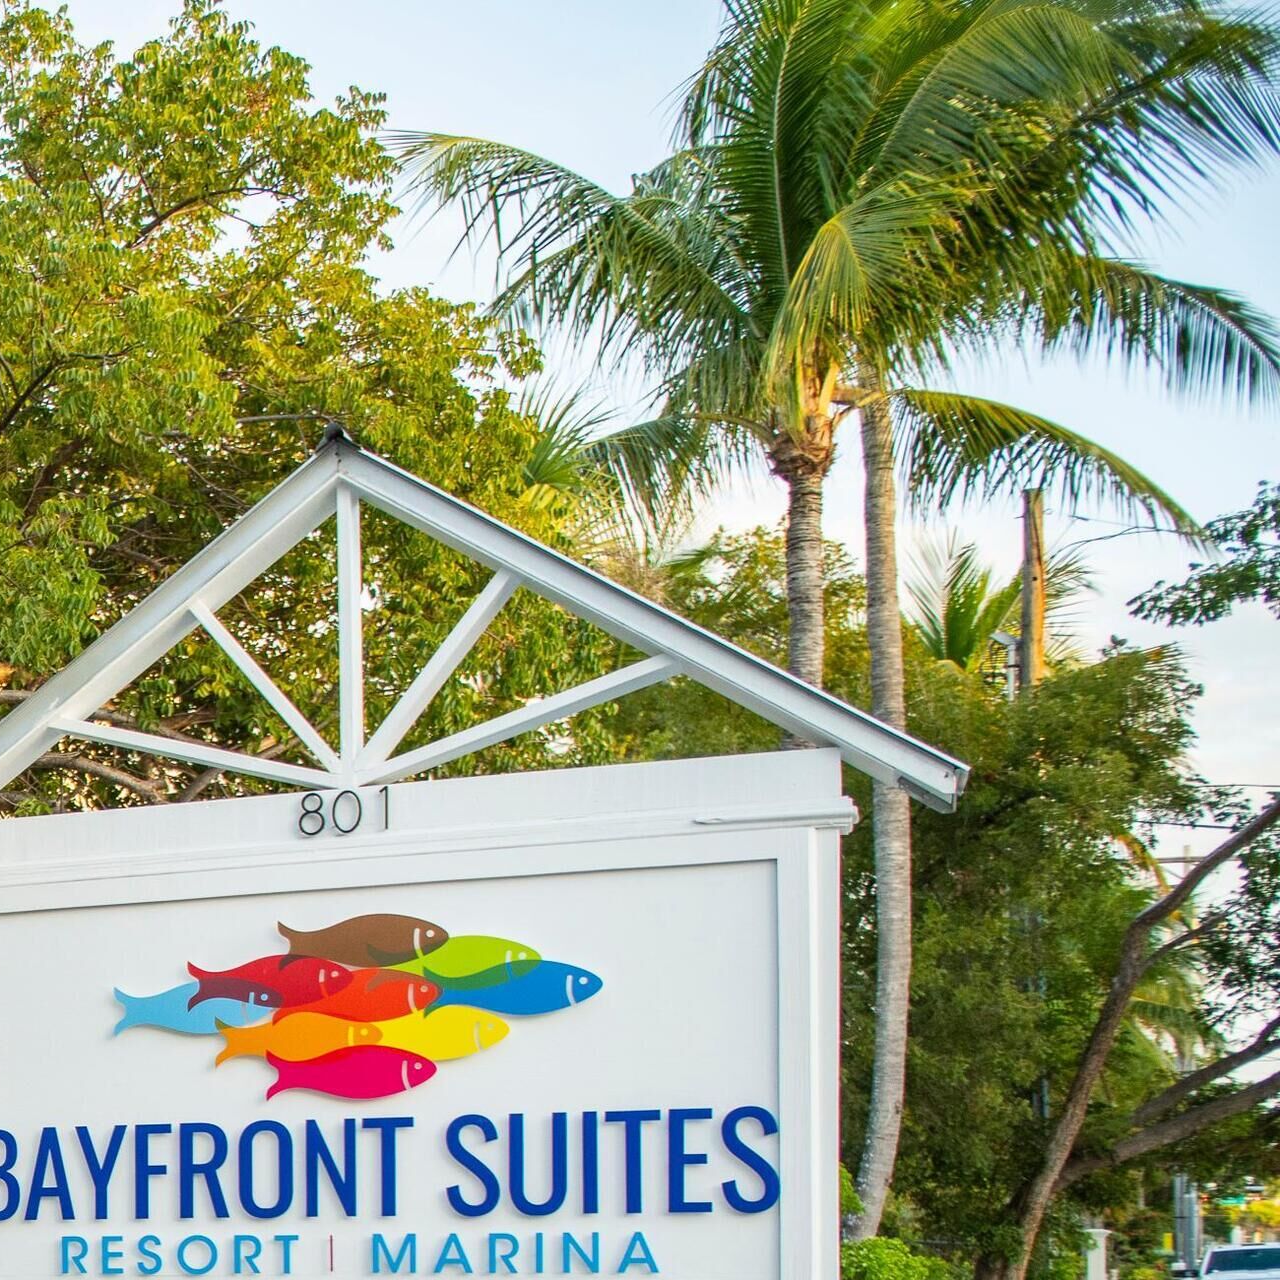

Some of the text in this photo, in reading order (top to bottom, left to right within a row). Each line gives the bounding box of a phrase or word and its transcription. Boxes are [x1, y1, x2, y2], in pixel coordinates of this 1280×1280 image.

[298, 786, 390, 836] 801
[446, 1105, 782, 1217] SUITES
[59, 1230, 661, 1276] RESORT MARINA
